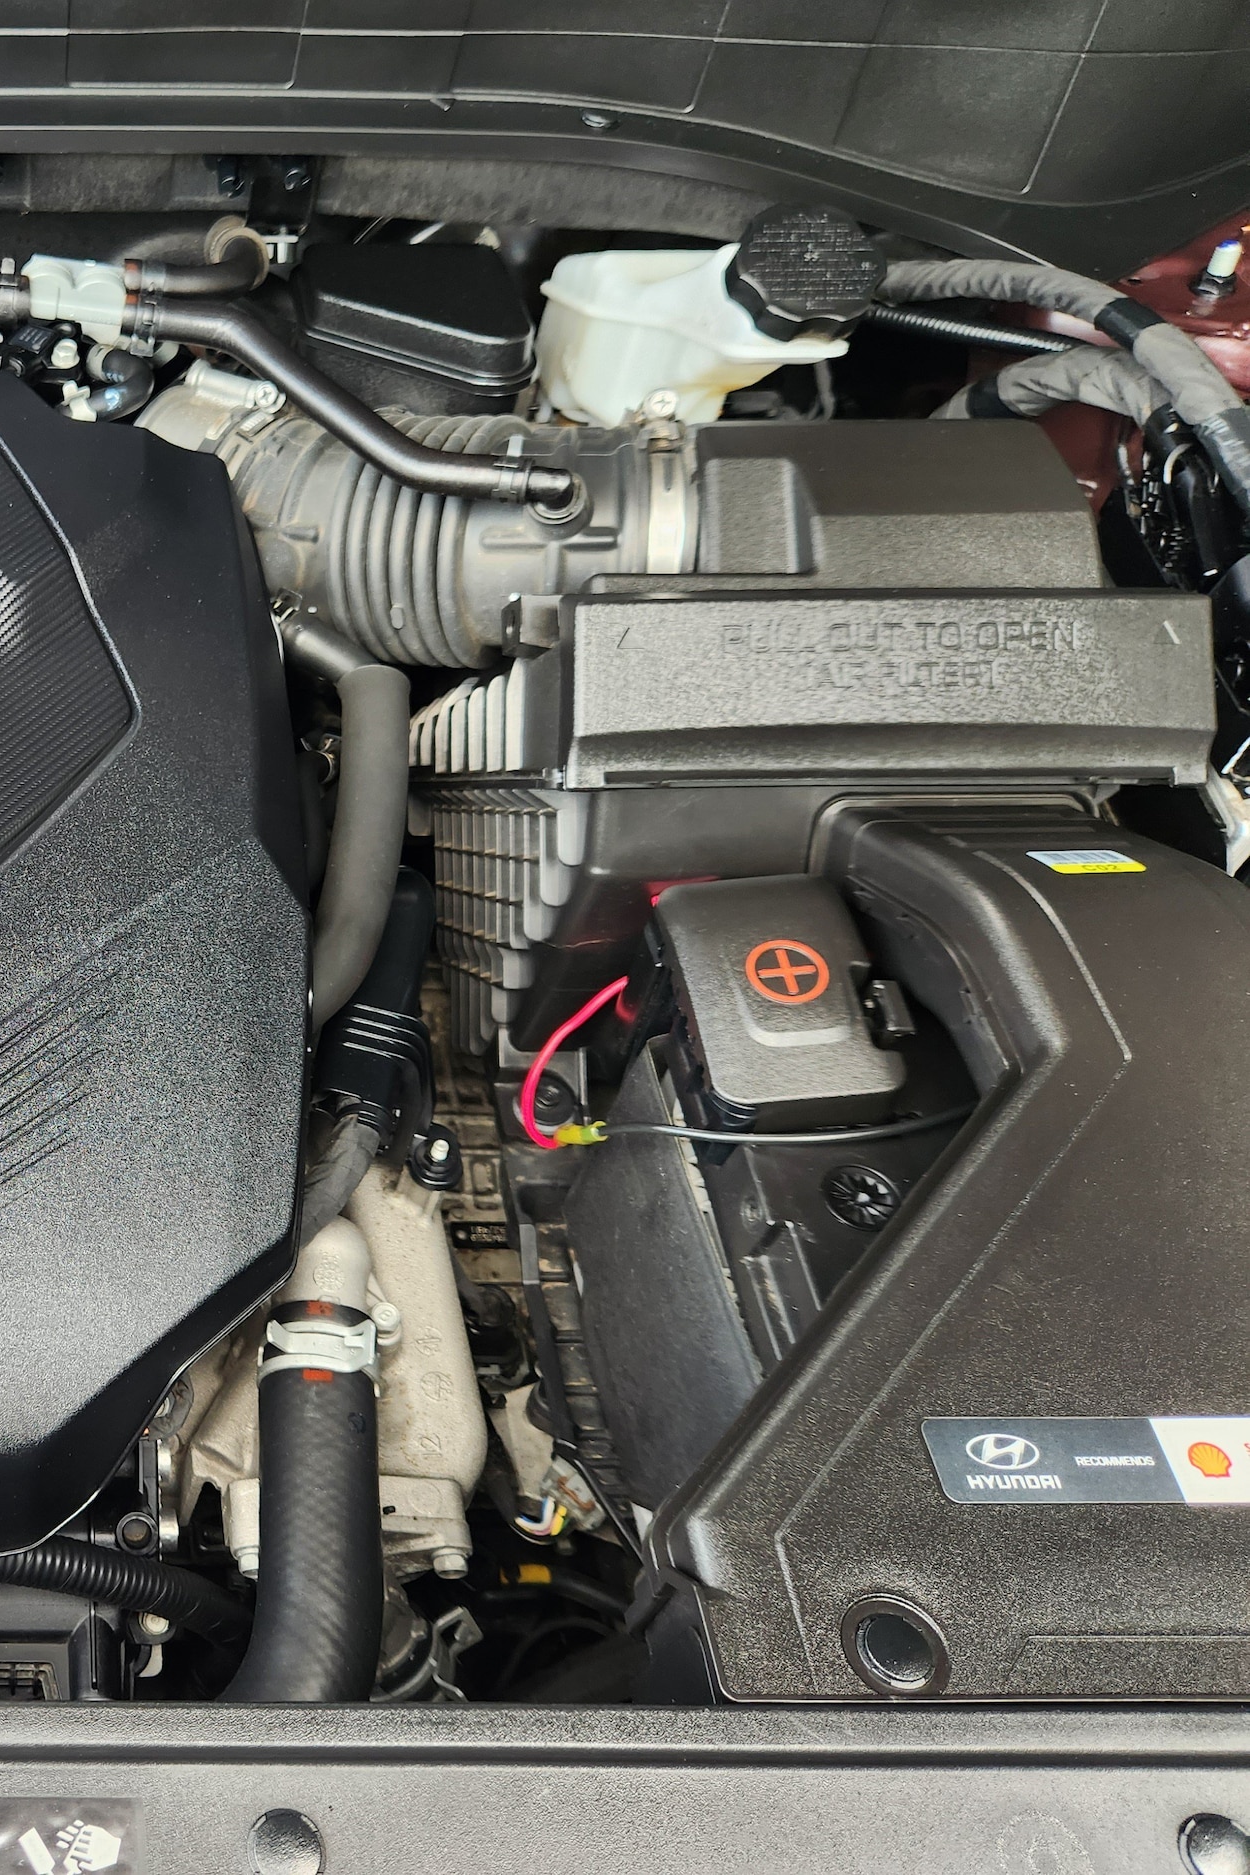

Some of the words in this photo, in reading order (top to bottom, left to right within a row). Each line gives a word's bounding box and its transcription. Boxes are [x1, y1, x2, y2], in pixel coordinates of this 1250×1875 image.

[721, 624, 816, 653] PULL
[829, 622, 905, 651] OUT
[914, 621, 961, 650] TO
[977, 621, 1077, 650] OPEN
[1074, 1455, 1156, 1467] RECOMMENDS
[965, 1474, 1063, 1490] HYUNDAI
